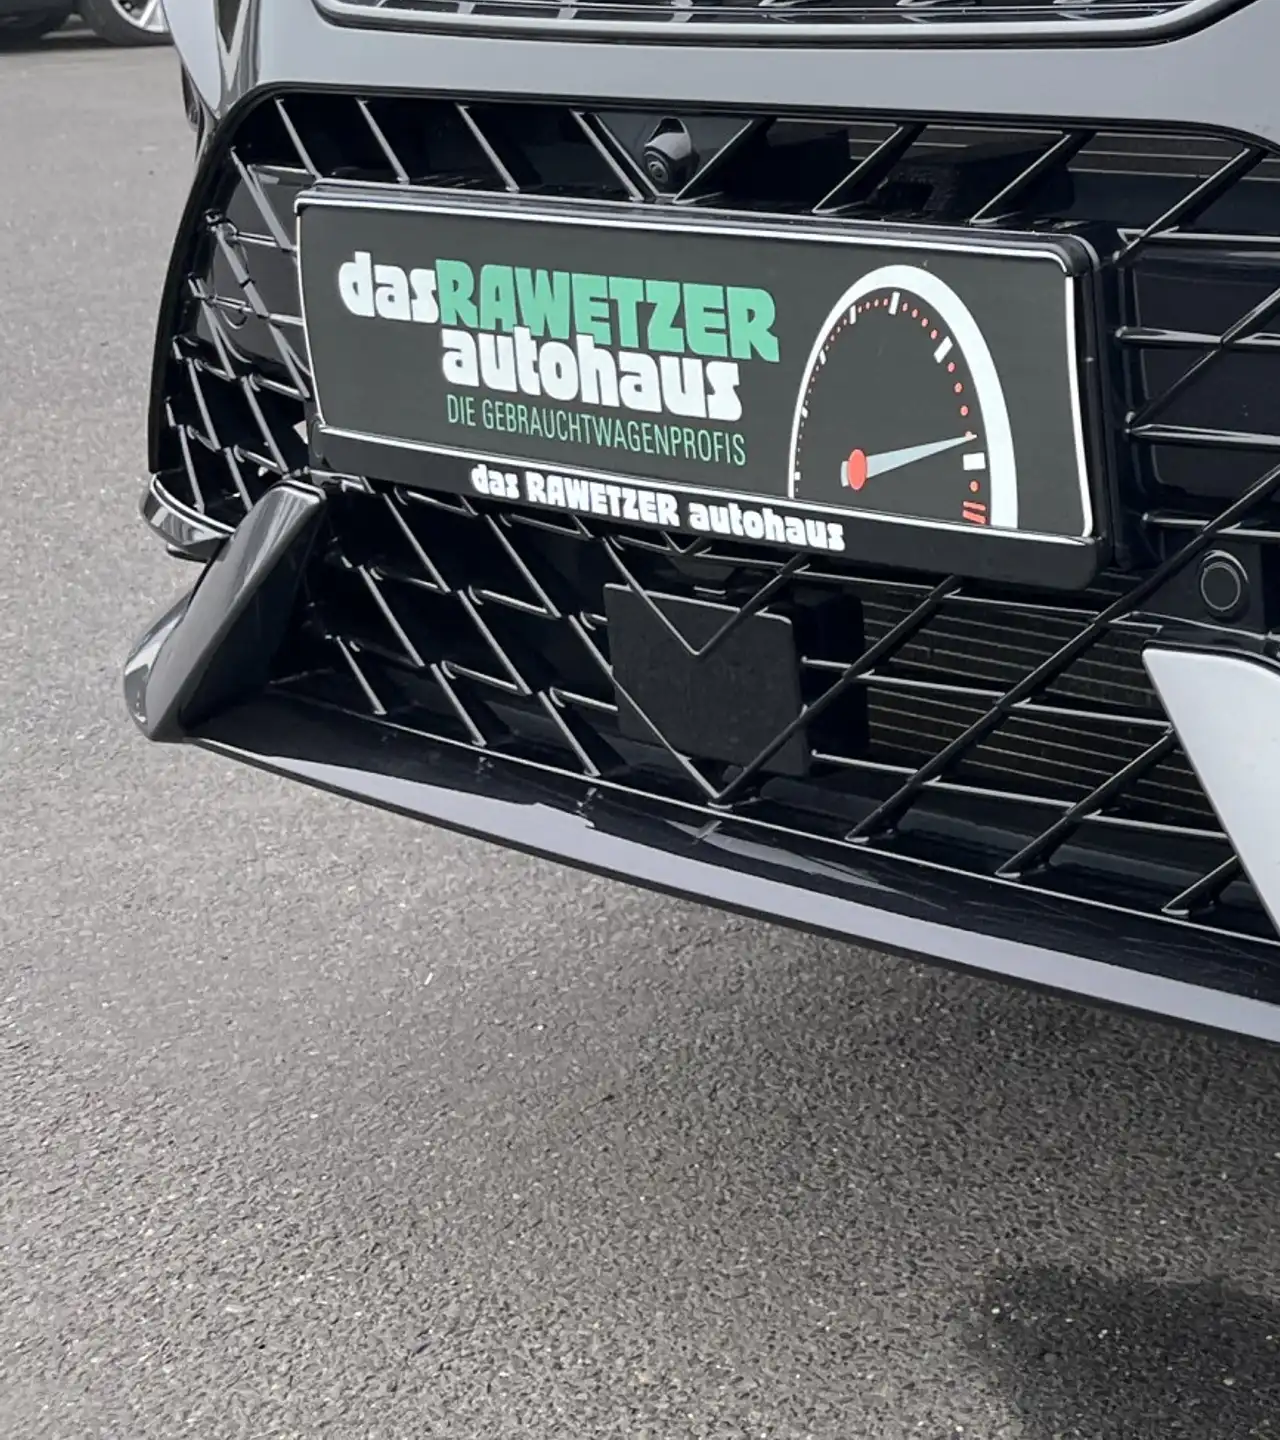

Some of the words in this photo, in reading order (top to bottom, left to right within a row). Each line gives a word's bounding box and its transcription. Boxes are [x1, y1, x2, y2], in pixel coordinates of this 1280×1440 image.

[442, 326, 743, 422] autohaus
[447, 394, 477, 427] DIE
[481, 398, 747, 467] GEBRAUCHTWAGENPROFIS
[470, 463, 520, 501] das
[525, 470, 681, 528] RAWETZER
[687, 500, 847, 552] autohaus
